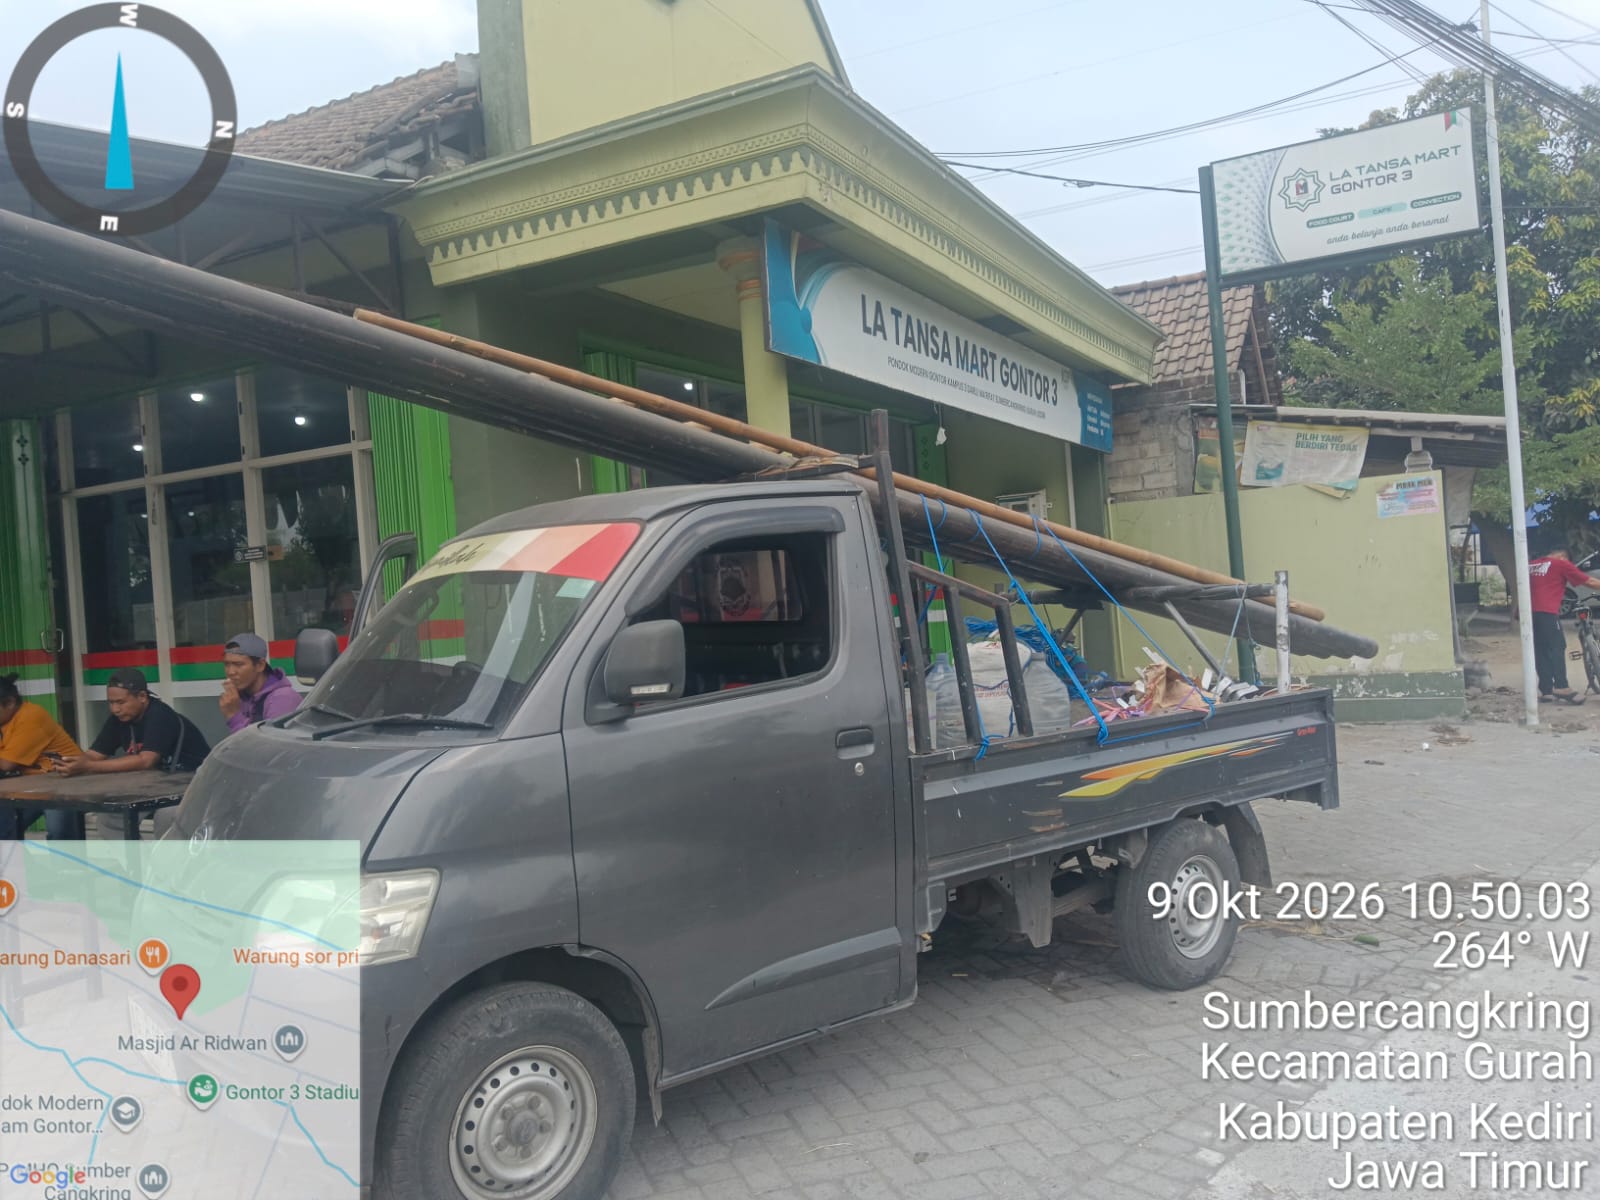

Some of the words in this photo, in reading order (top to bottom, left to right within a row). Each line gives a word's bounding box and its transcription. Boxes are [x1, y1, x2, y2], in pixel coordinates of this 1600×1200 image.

[1329, 170, 1352, 181] LA
[1355, 156, 1411, 175] TANSA
[1415, 145, 1461, 164] MART
[1330, 172, 1398, 195] GONTOR
[1401, 169, 1413, 181] 3
[1327, 231, 1349, 244] anda
[1351, 227, 1384, 242] belanja
[1386, 220, 1409, 233] anda
[1411, 215, 1449, 229] beramal
[861, 293, 888, 341] LA
[890, 306, 953, 367] TANSA
[955, 335, 998, 384] MART
[999, 357, 1051, 406] GONTOR
[1051, 378, 1058, 406] 3
[1295, 440, 1328, 450] BERDIRI
[1296, 432, 1319, 442] PILIH
[1320, 434, 1344, 444] YANG
